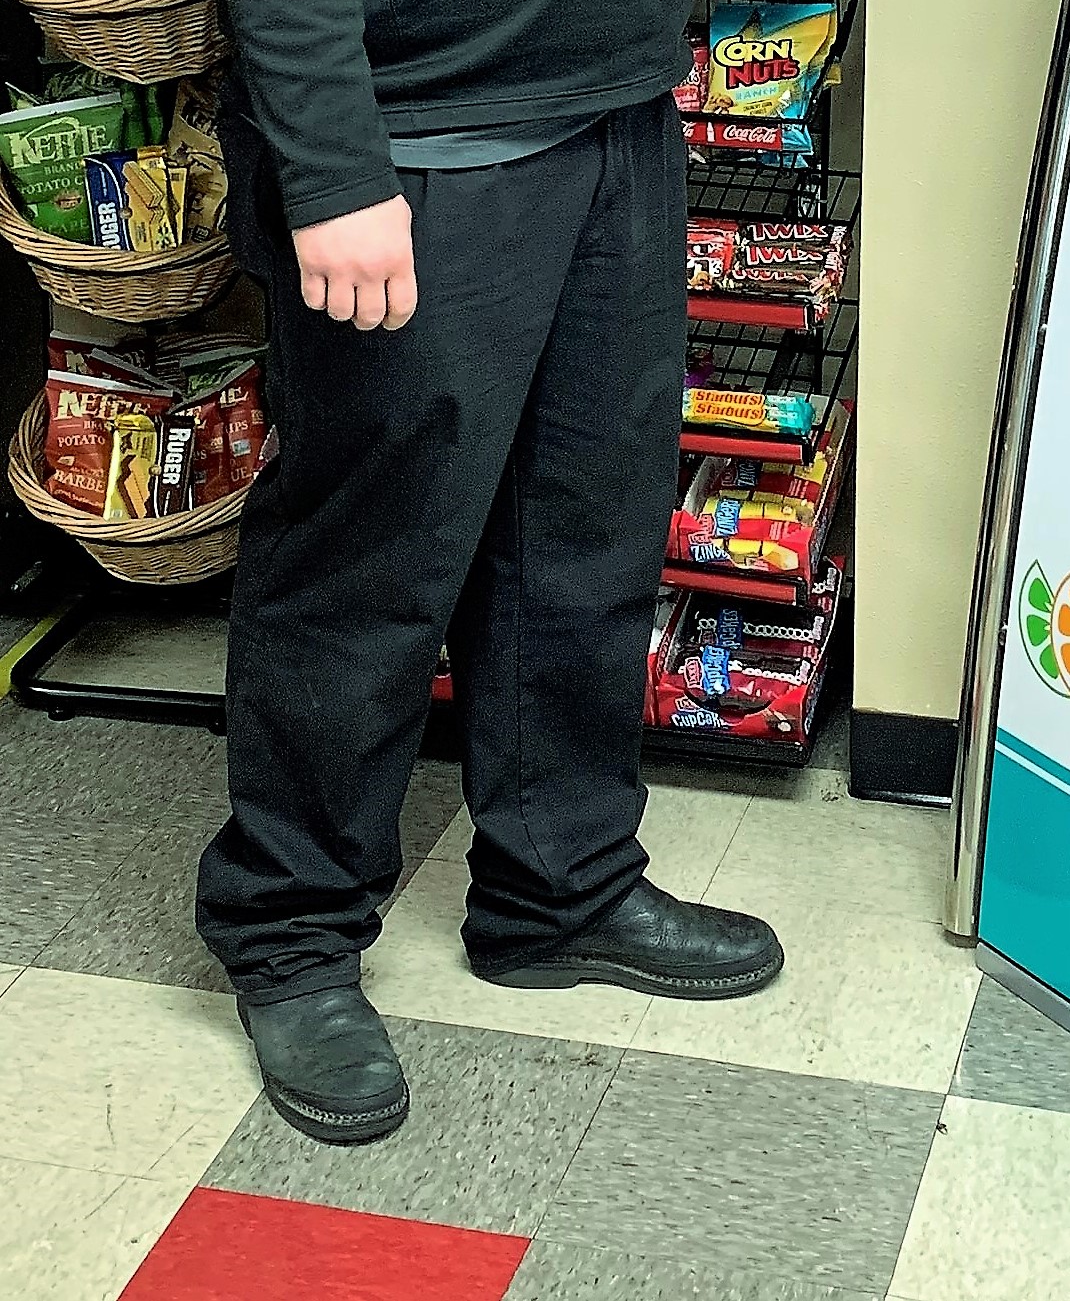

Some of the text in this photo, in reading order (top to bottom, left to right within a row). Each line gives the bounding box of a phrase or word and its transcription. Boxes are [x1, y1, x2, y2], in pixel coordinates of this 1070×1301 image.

[715, 36, 792, 67] CORN
[728, 59, 800, 89] NUTS
[4, 116, 113, 169] KETTLE
[44, 161, 82, 175] BRAND
[228, 419, 249, 434] IPS
[58, 434, 106, 448] POTATO
[162, 428, 192, 485] RUGER
[54, 469, 106, 494] BARBE
